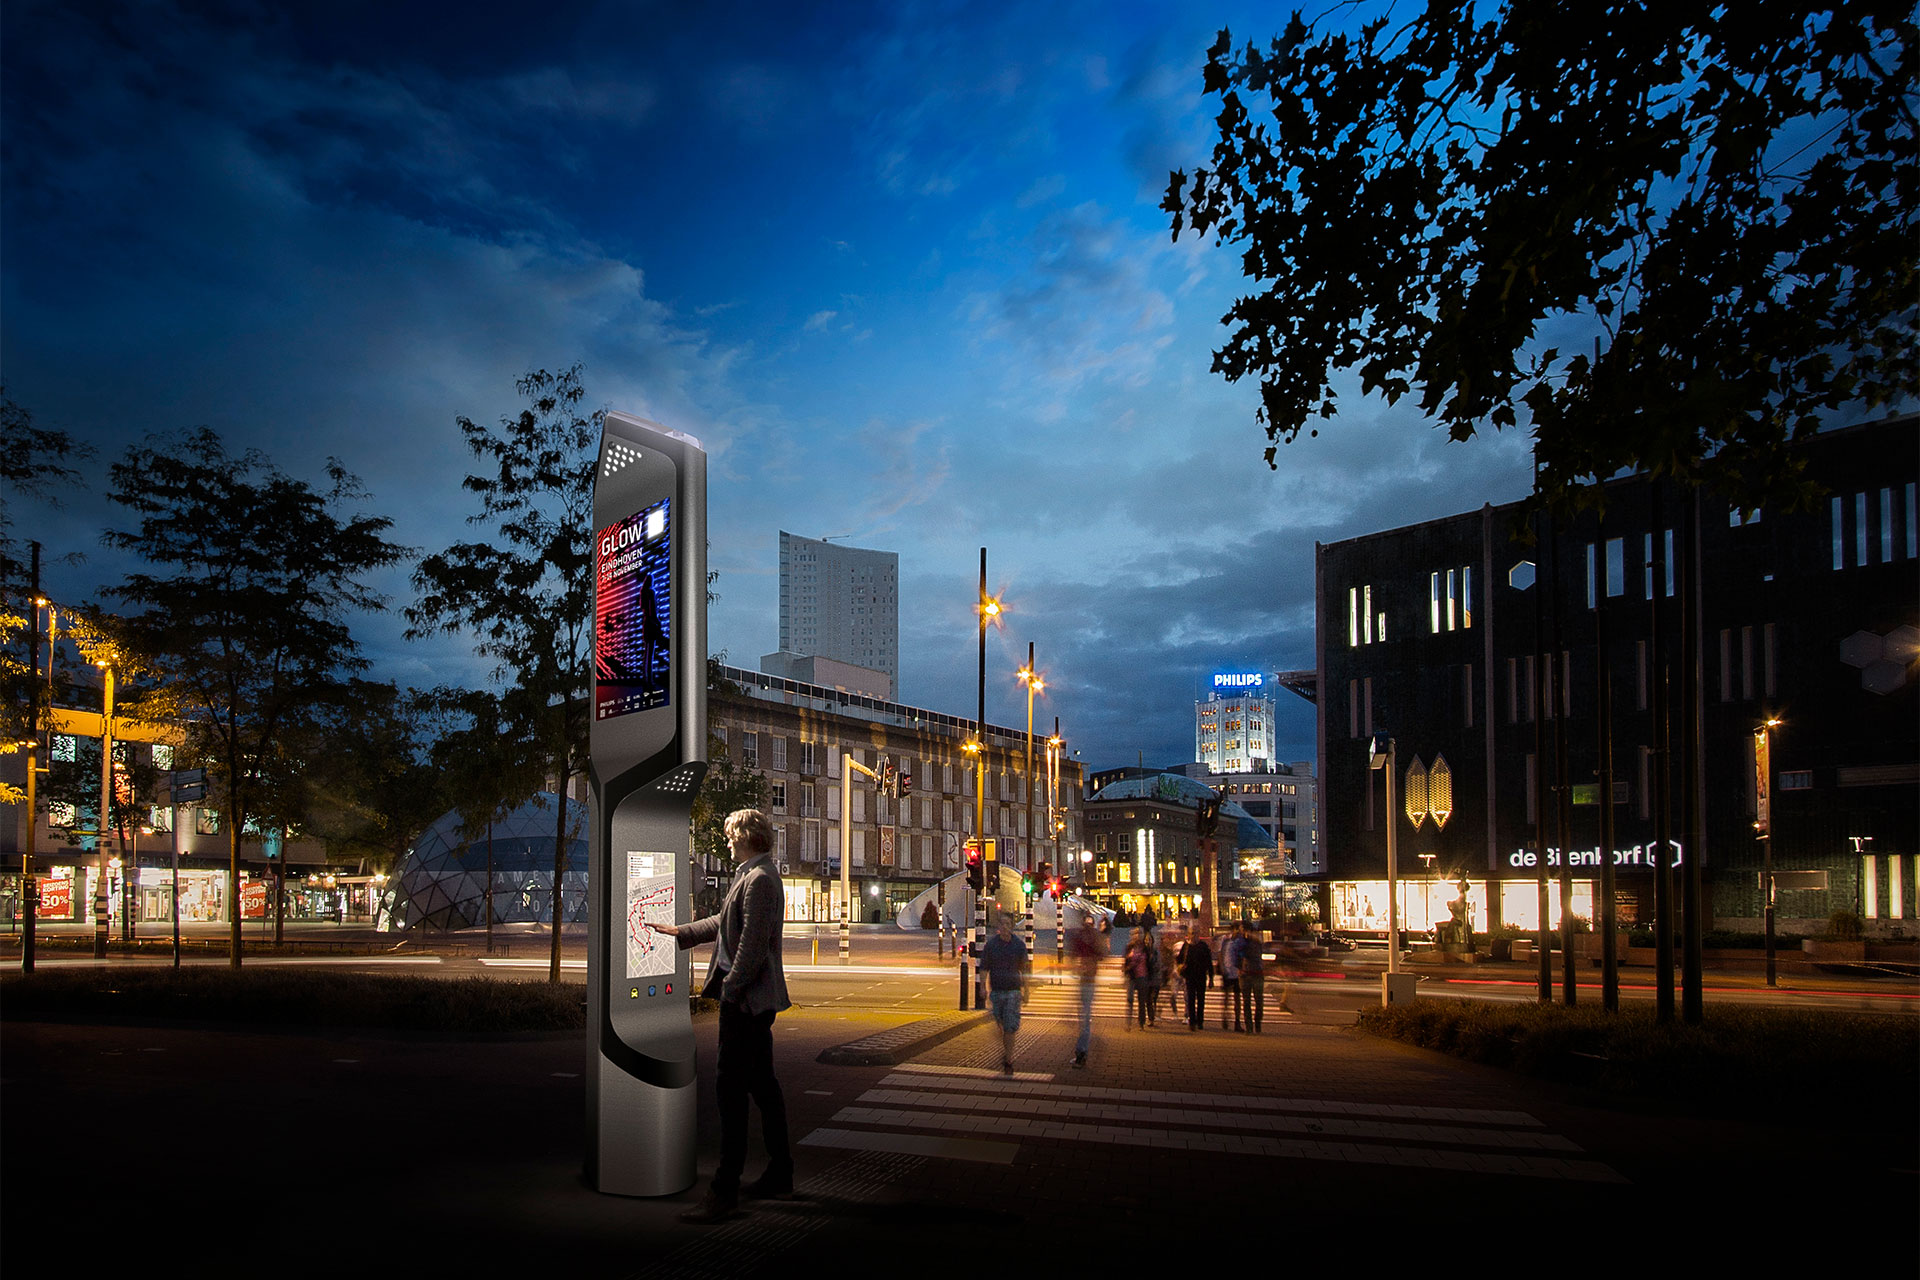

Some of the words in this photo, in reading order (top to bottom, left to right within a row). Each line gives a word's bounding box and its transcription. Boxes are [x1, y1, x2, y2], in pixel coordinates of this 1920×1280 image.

[601, 521, 643, 556] GLOW
[601, 547, 643, 573] EINDHOVEN
[613, 559, 643, 578] NOVEMBER
[1214, 673, 1262, 686] PHILIPS
[1509, 849, 1538, 867] de
[42, 895, 69, 907] 50%
